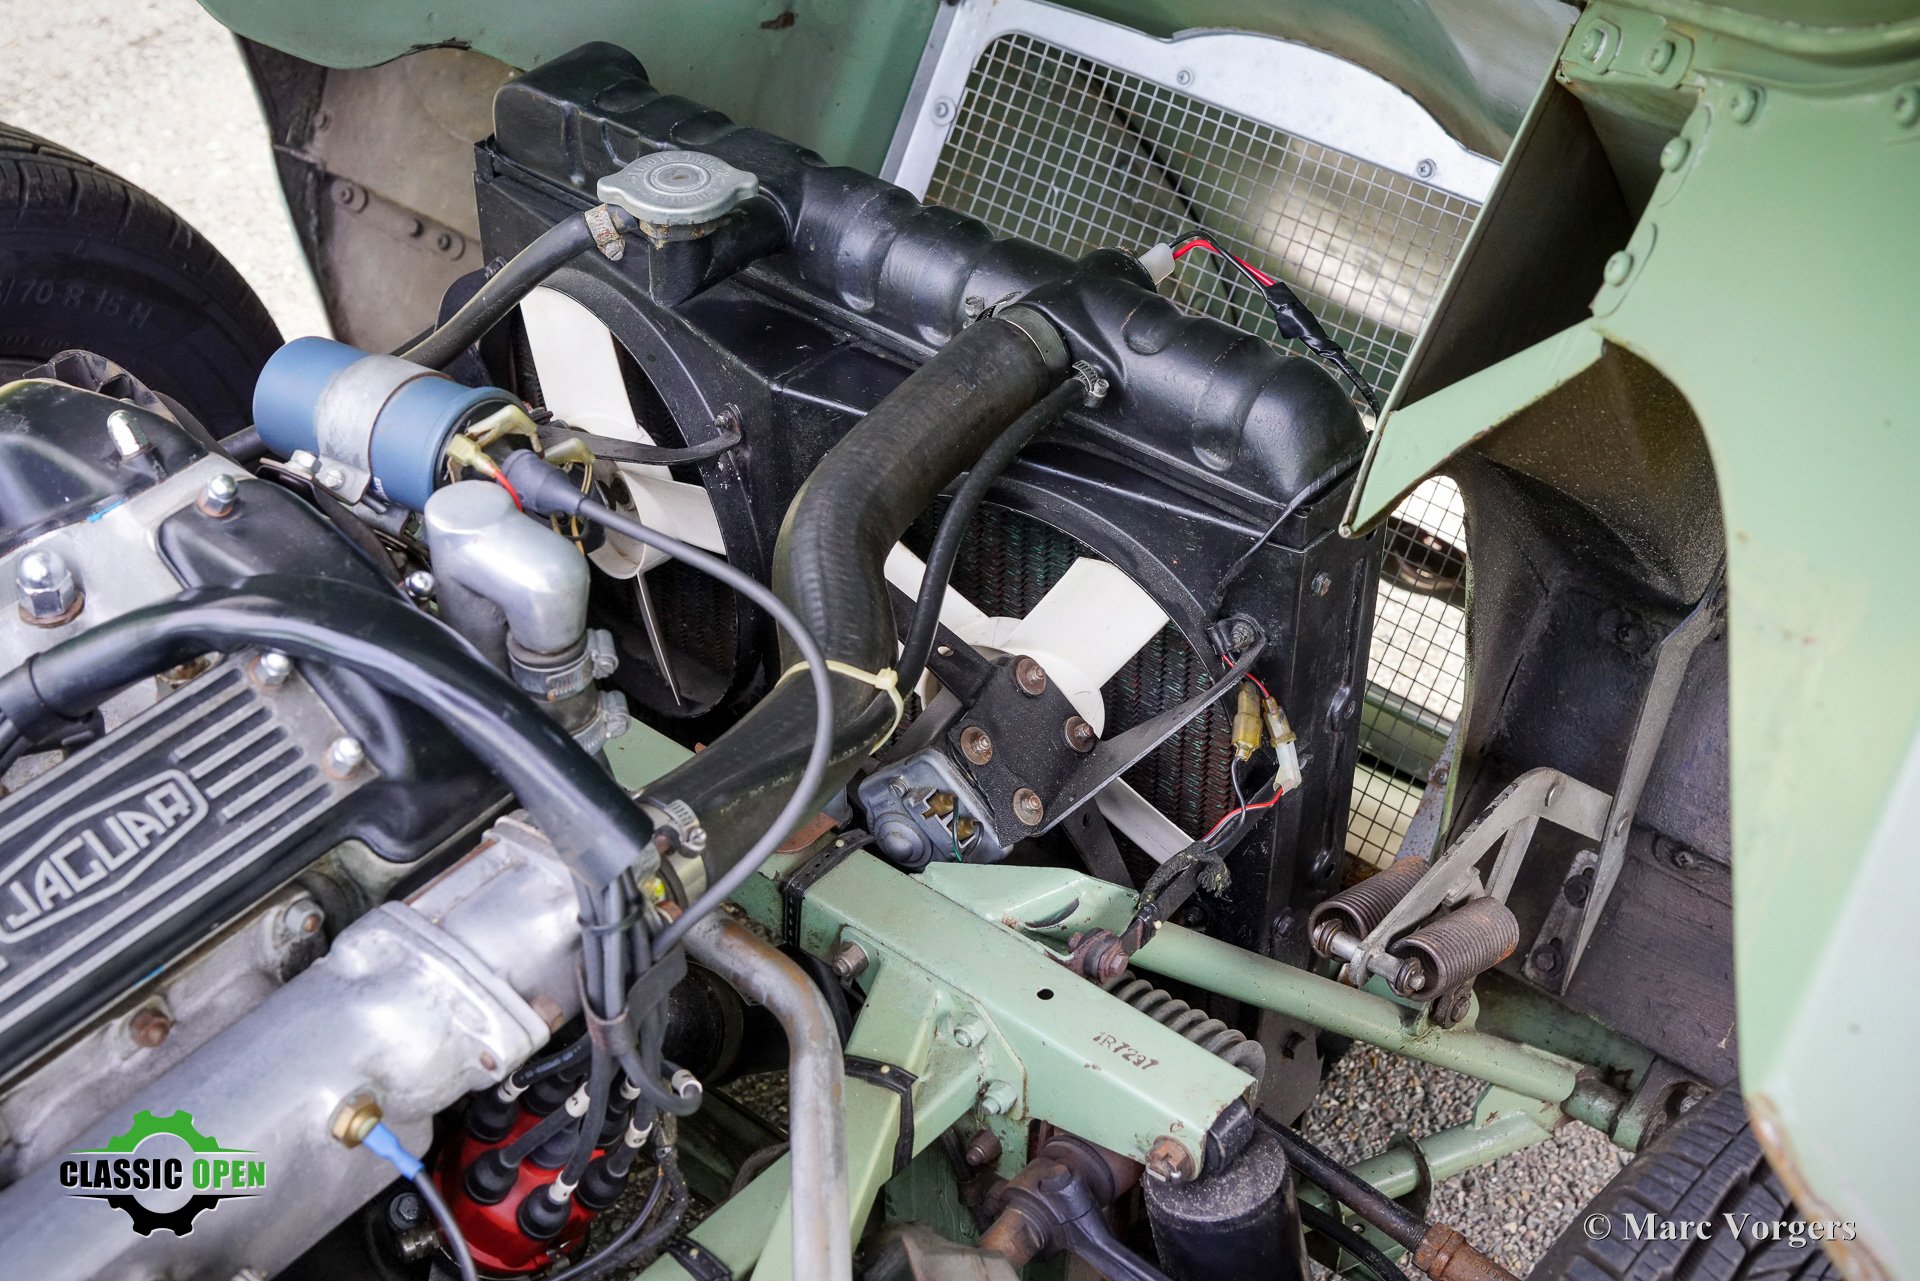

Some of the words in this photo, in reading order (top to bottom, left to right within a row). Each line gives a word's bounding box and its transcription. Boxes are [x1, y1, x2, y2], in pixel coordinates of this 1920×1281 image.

[0, 275, 54, 305] /70
[63, 283, 86, 308] R
[95, 289, 124, 316] 15
[127, 301, 152, 329] H
[6, 780, 191, 930] JAGUAR
